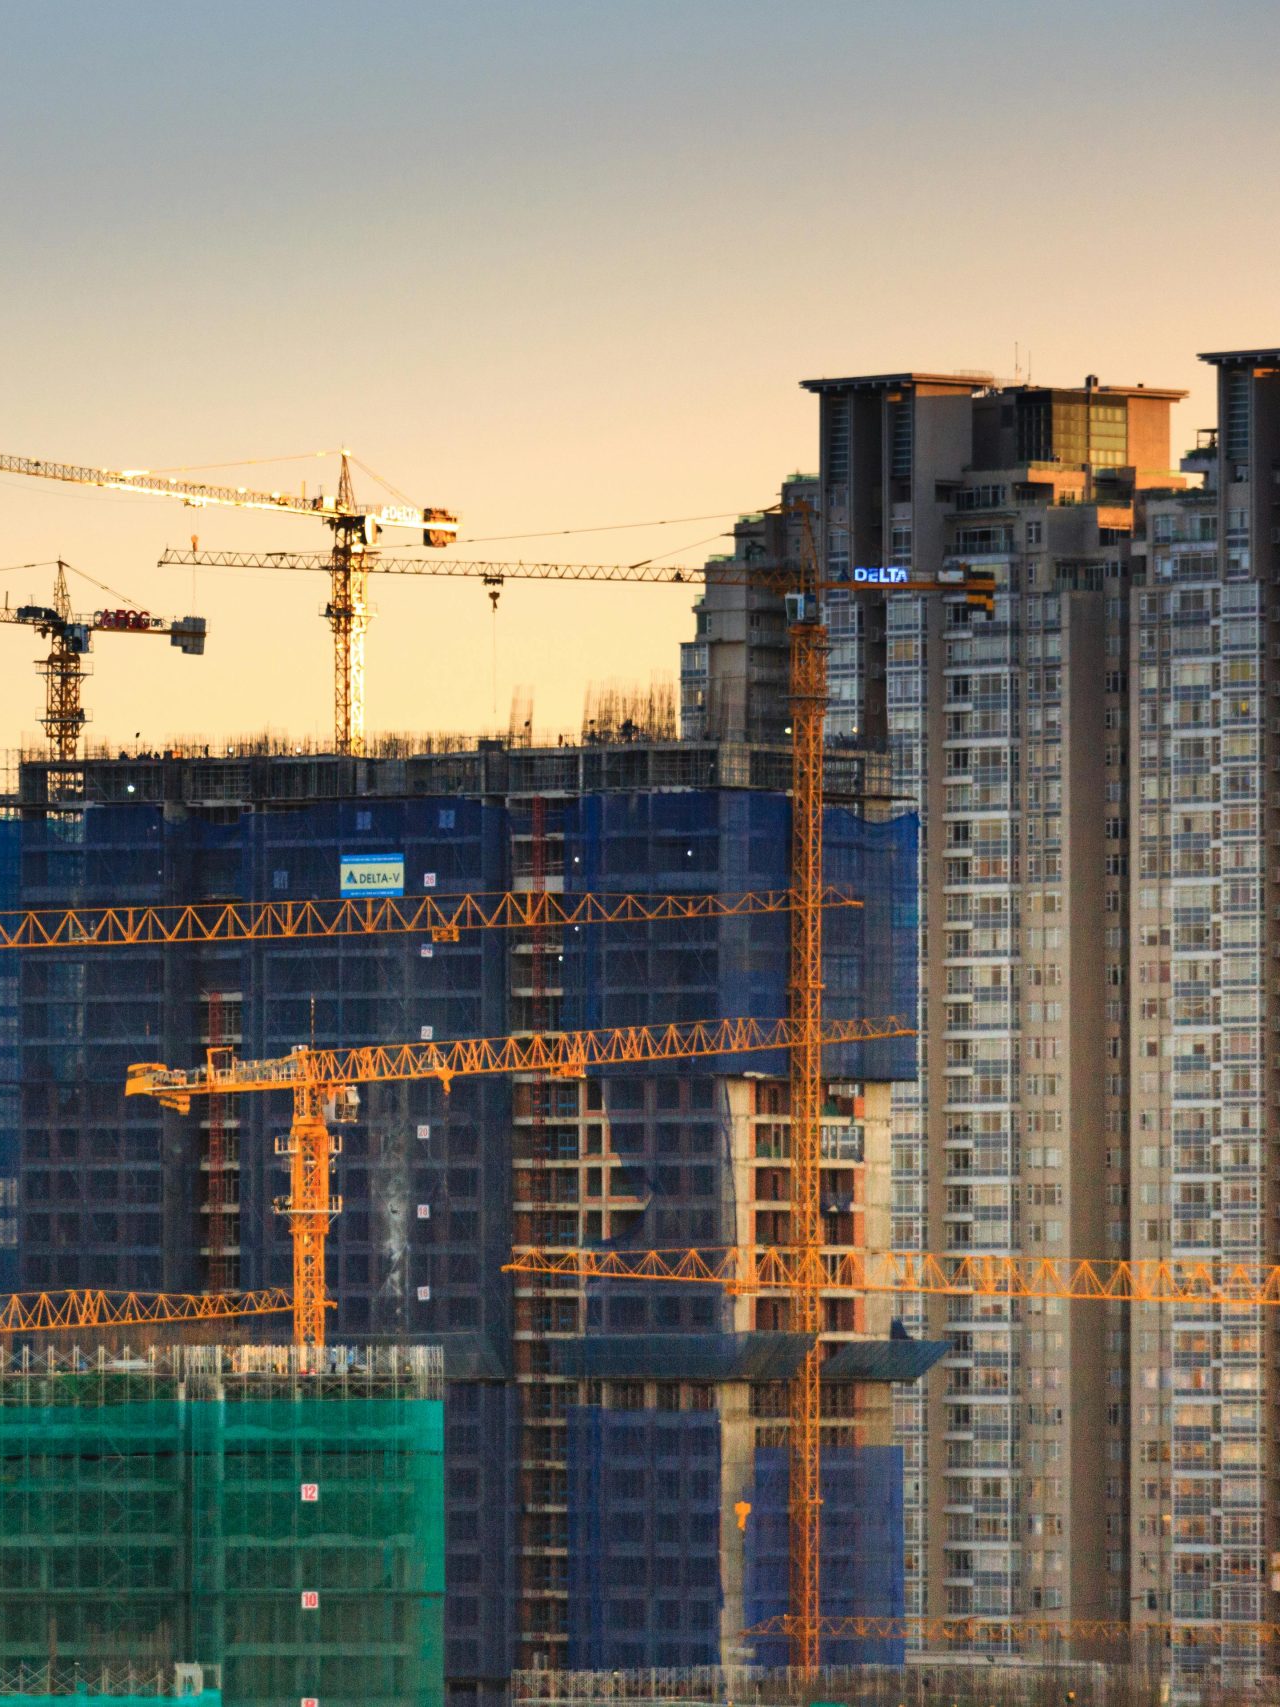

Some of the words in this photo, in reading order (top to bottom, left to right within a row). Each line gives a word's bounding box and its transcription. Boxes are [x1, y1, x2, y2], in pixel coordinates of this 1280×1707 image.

[854, 568, 908, 582] DELTA
[360, 872, 400, 884] DELTA-V
[304, 1485, 316, 1498] 12
[304, 1593, 316, 1606] 10
